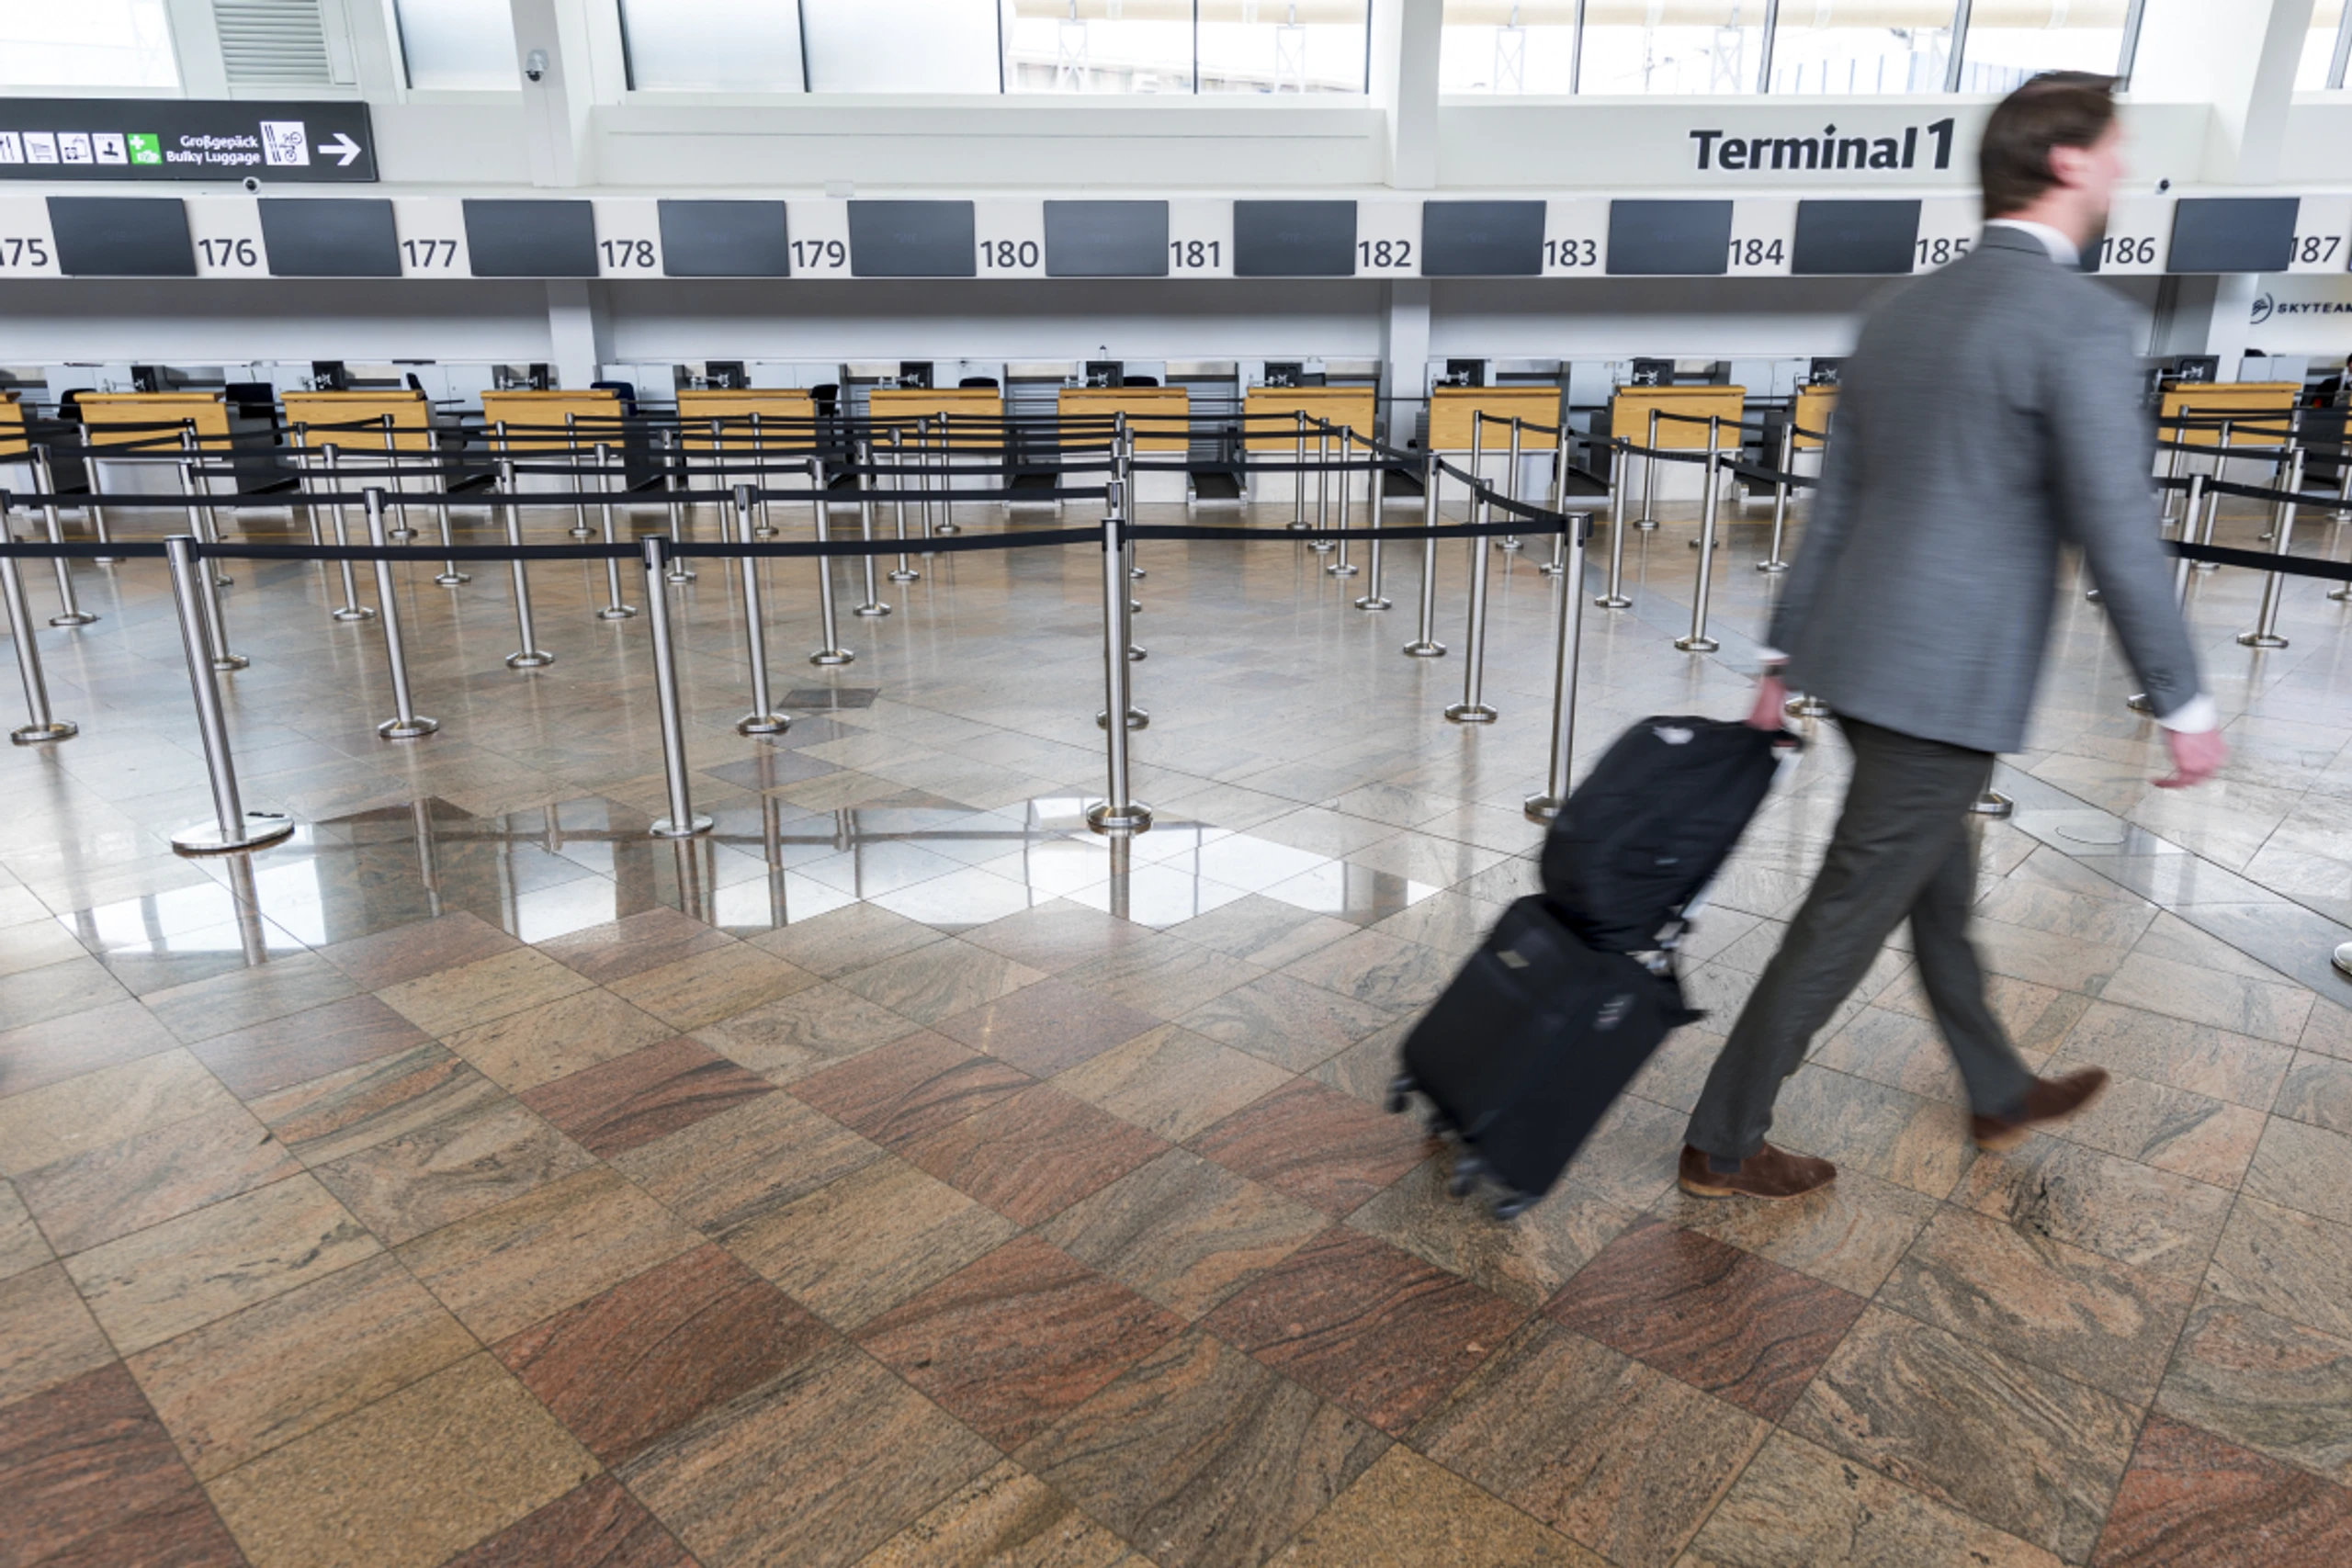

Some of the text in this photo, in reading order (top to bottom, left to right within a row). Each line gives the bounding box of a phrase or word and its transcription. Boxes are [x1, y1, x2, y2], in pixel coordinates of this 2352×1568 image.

[179, 135, 260, 150] Großgepäck
[1690, 118, 1955, 170] Terminal 1
[165, 151, 261, 165] Bulky Luggage
[198, 239, 257, 266] 176
[402, 240, 458, 267] 177
[600, 240, 655, 267] 178
[791, 240, 846, 267] 179
[980, 240, 1039, 267] 180
[1170, 240, 1220, 267] 181
[1358, 240, 1412, 267] 182
[1544, 239, 1597, 266] 183
[1730, 238, 1784, 265] 184
[1917, 238, 1971, 265] 185
[2103, 237, 2155, 264] 186
[2290, 236, 2341, 263] 187
